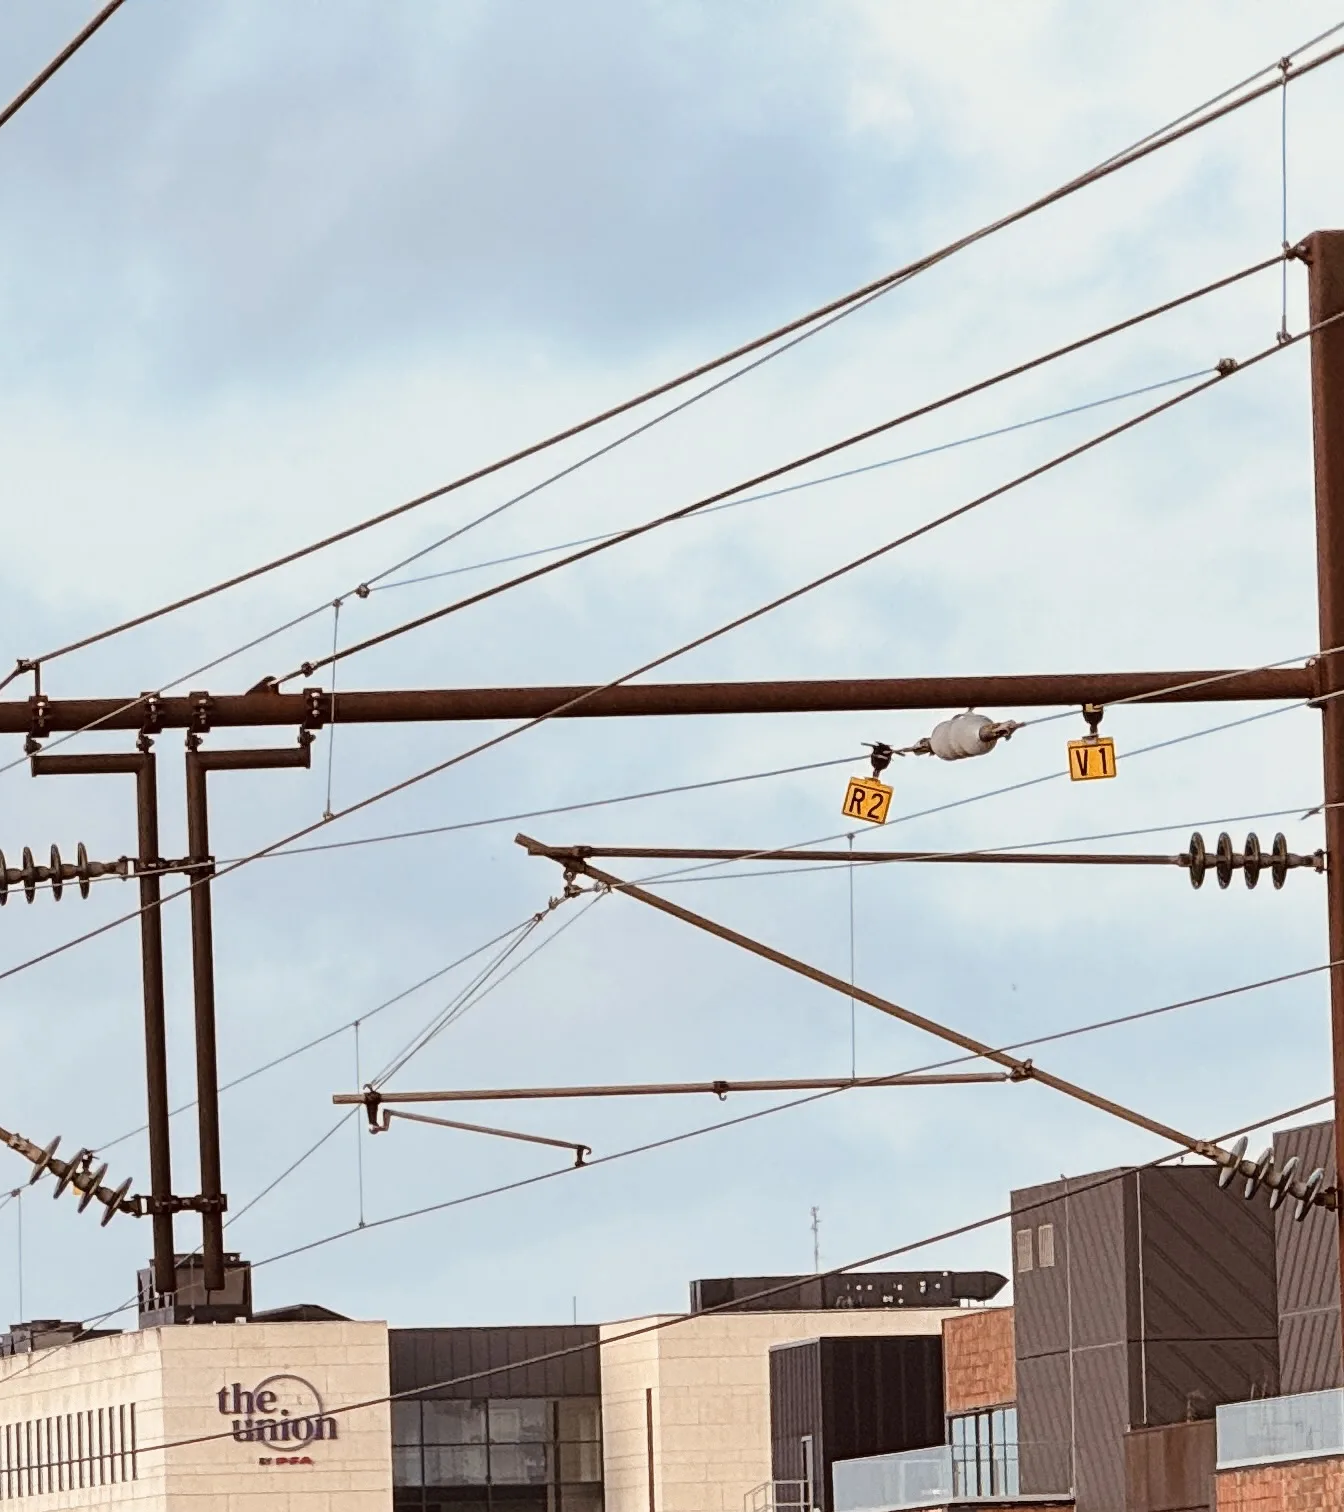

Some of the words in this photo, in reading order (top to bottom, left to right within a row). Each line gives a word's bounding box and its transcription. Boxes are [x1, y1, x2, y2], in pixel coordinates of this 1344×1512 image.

[1075, 747, 1110, 777] V1
[848, 787, 885, 820] R2
[216, 1382, 277, 1415] the
[231, 1408, 339, 1442] union
